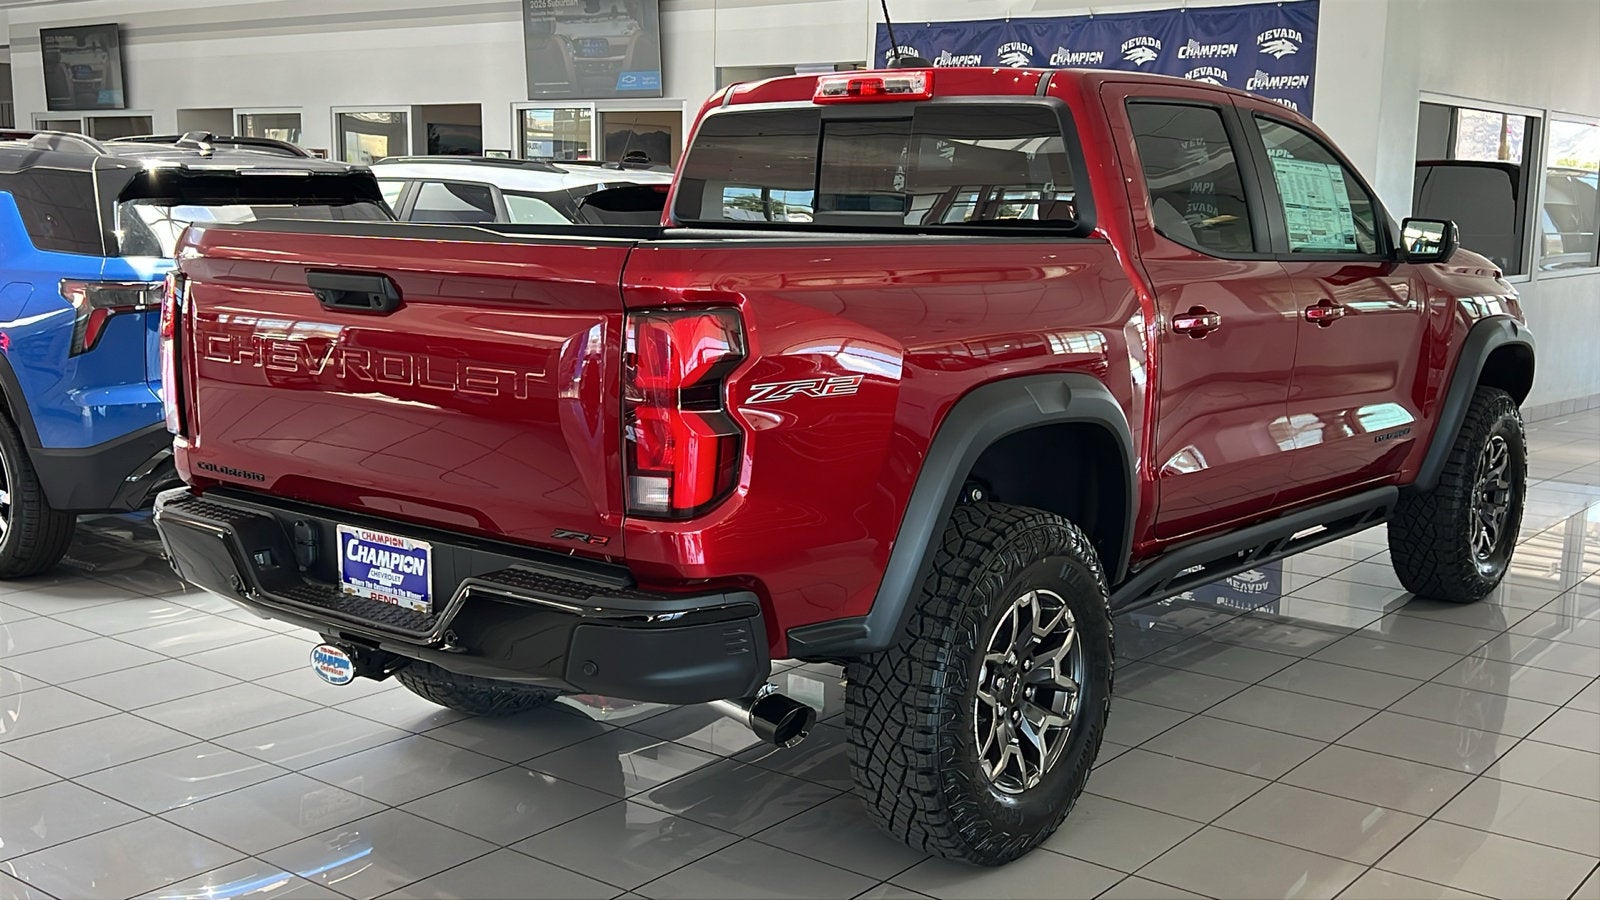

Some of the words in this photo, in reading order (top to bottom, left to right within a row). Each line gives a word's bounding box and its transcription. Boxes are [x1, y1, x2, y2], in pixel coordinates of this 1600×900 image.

[1256, 28, 1303, 44] NEVADA
[997, 41, 1034, 57] NEVADA
[1121, 36, 1162, 53] NEVADA
[1178, 42, 1238, 58] CHAMPION
[933, 53, 982, 68] CHAMPION
[1050, 50, 1104, 66] CHAMPION
[1184, 66, 1228, 81] NEVADA
[1245, 74, 1309, 90] CHAMPION
[203, 334, 546, 399] CHEVROLET
[745, 375, 864, 405] ZR2
[361, 531, 404, 548] CHAMPION
[551, 528, 611, 546] ZR2
[346, 538, 425, 576] CHAMPION
[370, 569, 402, 583] CHEVROLET
[370, 592, 399, 606] RENO
